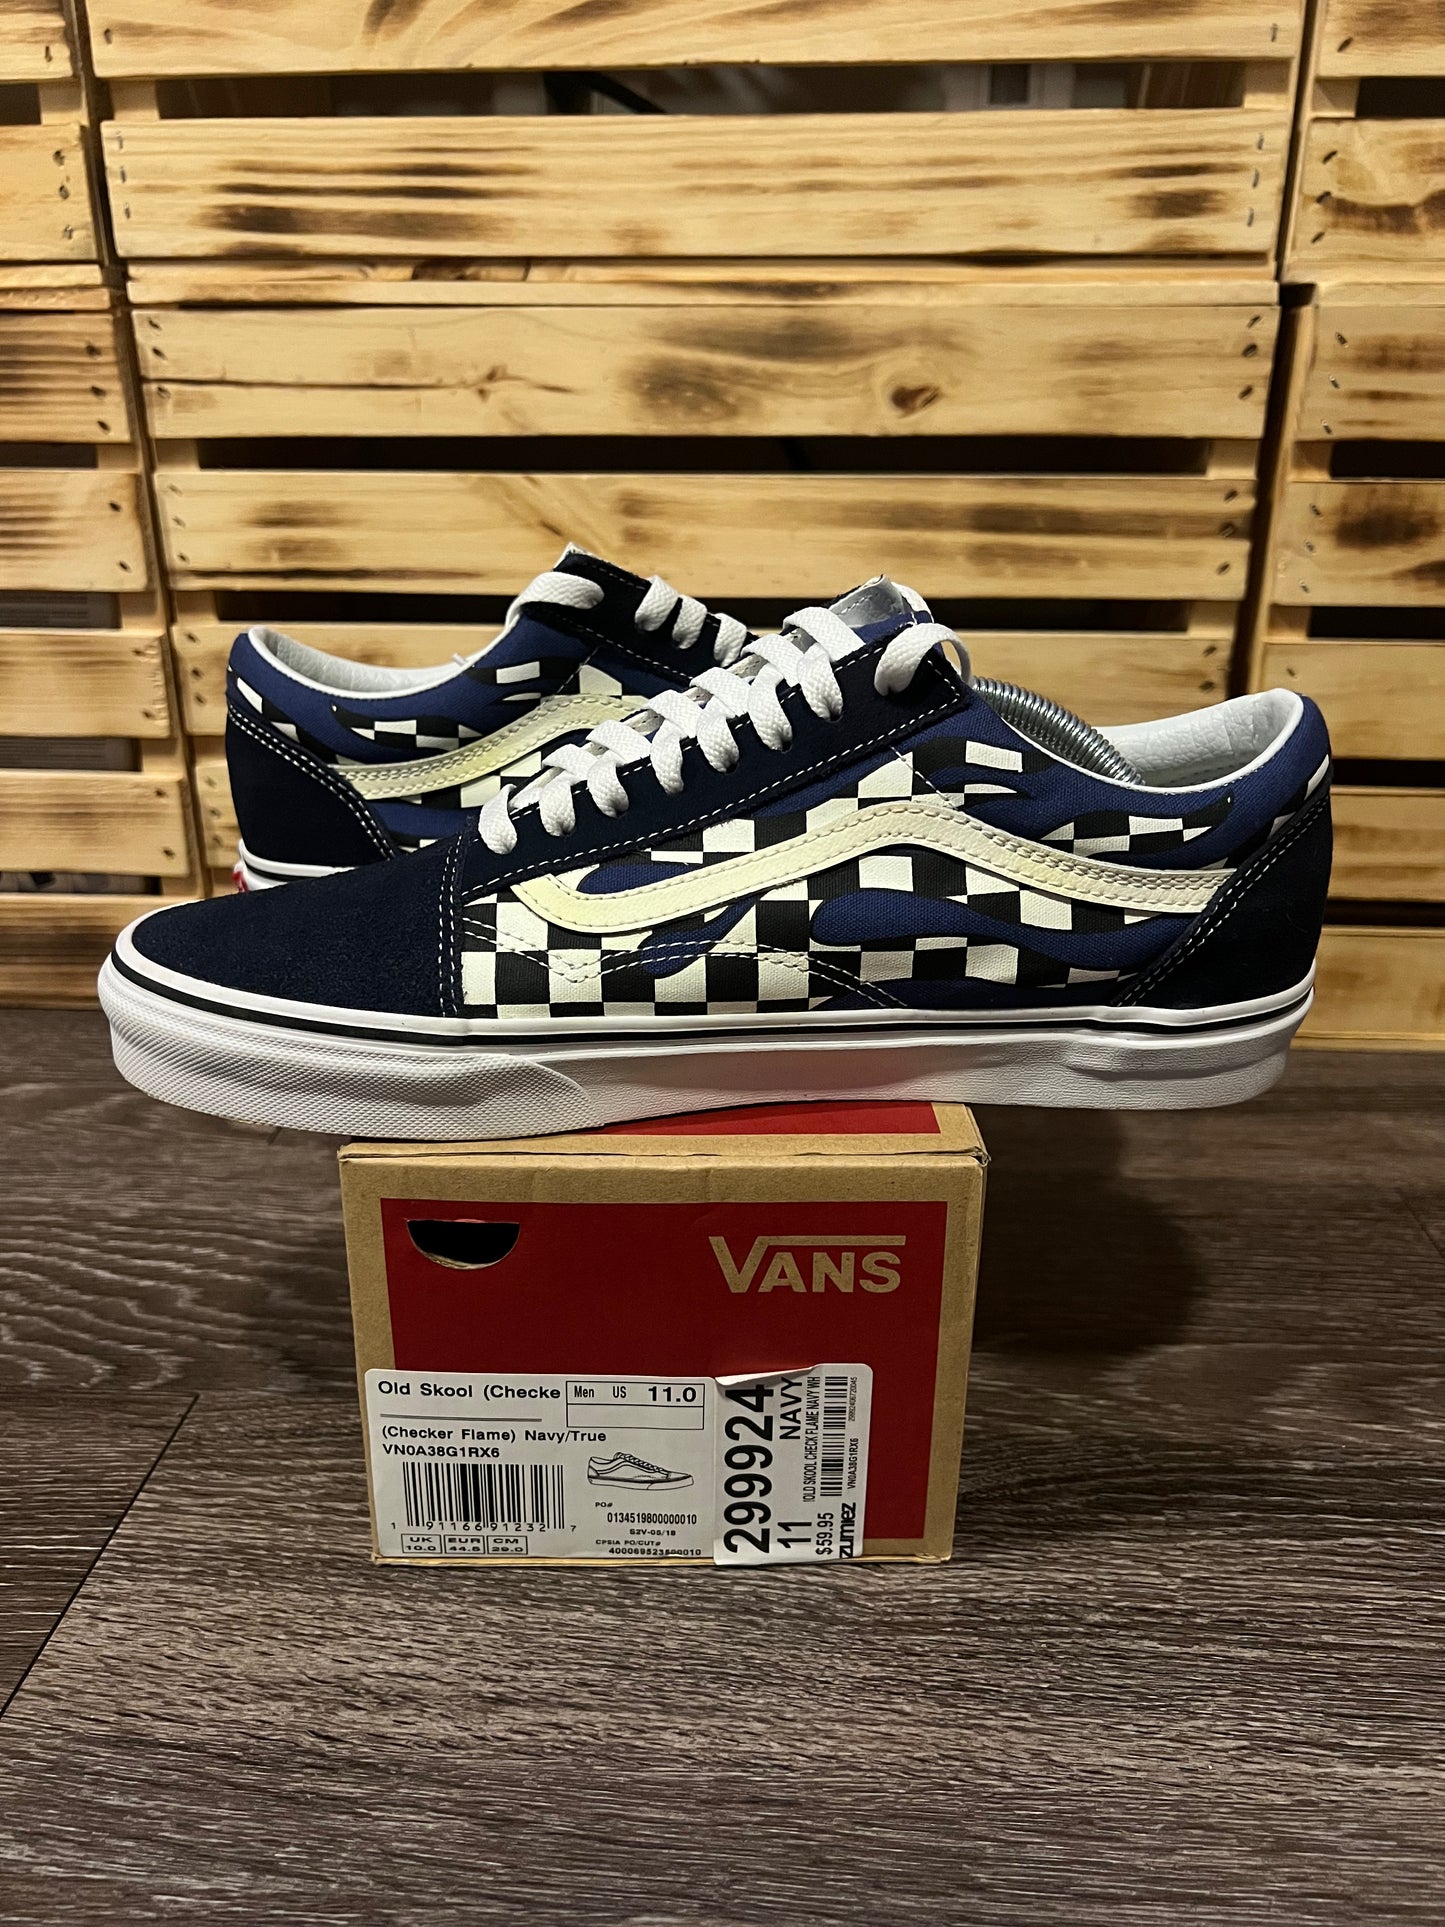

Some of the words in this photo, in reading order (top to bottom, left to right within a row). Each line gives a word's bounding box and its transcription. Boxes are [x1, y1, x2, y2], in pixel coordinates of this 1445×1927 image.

[708, 1235, 906, 1293] VANS
[378, 1381, 410, 1395] Old
[420, 1383, 473, 1398] Skool
[483, 1384, 561, 1401] (Checke
[807, 1376, 820, 1388] WH
[574, 1385, 595, 1398] Men
[612, 1386, 627, 1399] US
[648, 1386, 697, 1403] 11.0
[807, 1390, 820, 1409] NAVY
[779, 1376, 802, 1440] NAVY
[806, 1411, 819, 1434] FLAME
[382, 1425, 453, 1439] (Checker
[461, 1429, 516, 1443] Flame)
[525, 1430, 607, 1444] Navy/True
[382, 1443, 500, 1458] VN0A38G1RX6
[805, 1436, 818, 1460] CHECK
[723, 1384, 774, 1554] 299924
[803, 1462, 817, 1485] SKOOL
[847, 1438, 859, 1489] VN0A38G1RX6
[607, 1512, 697, 1525] 0134519800000010
[840, 1502, 856, 1558] zumiez
[777, 1521, 812, 1549] 11
[816, 1512, 834, 1555] $59.95
